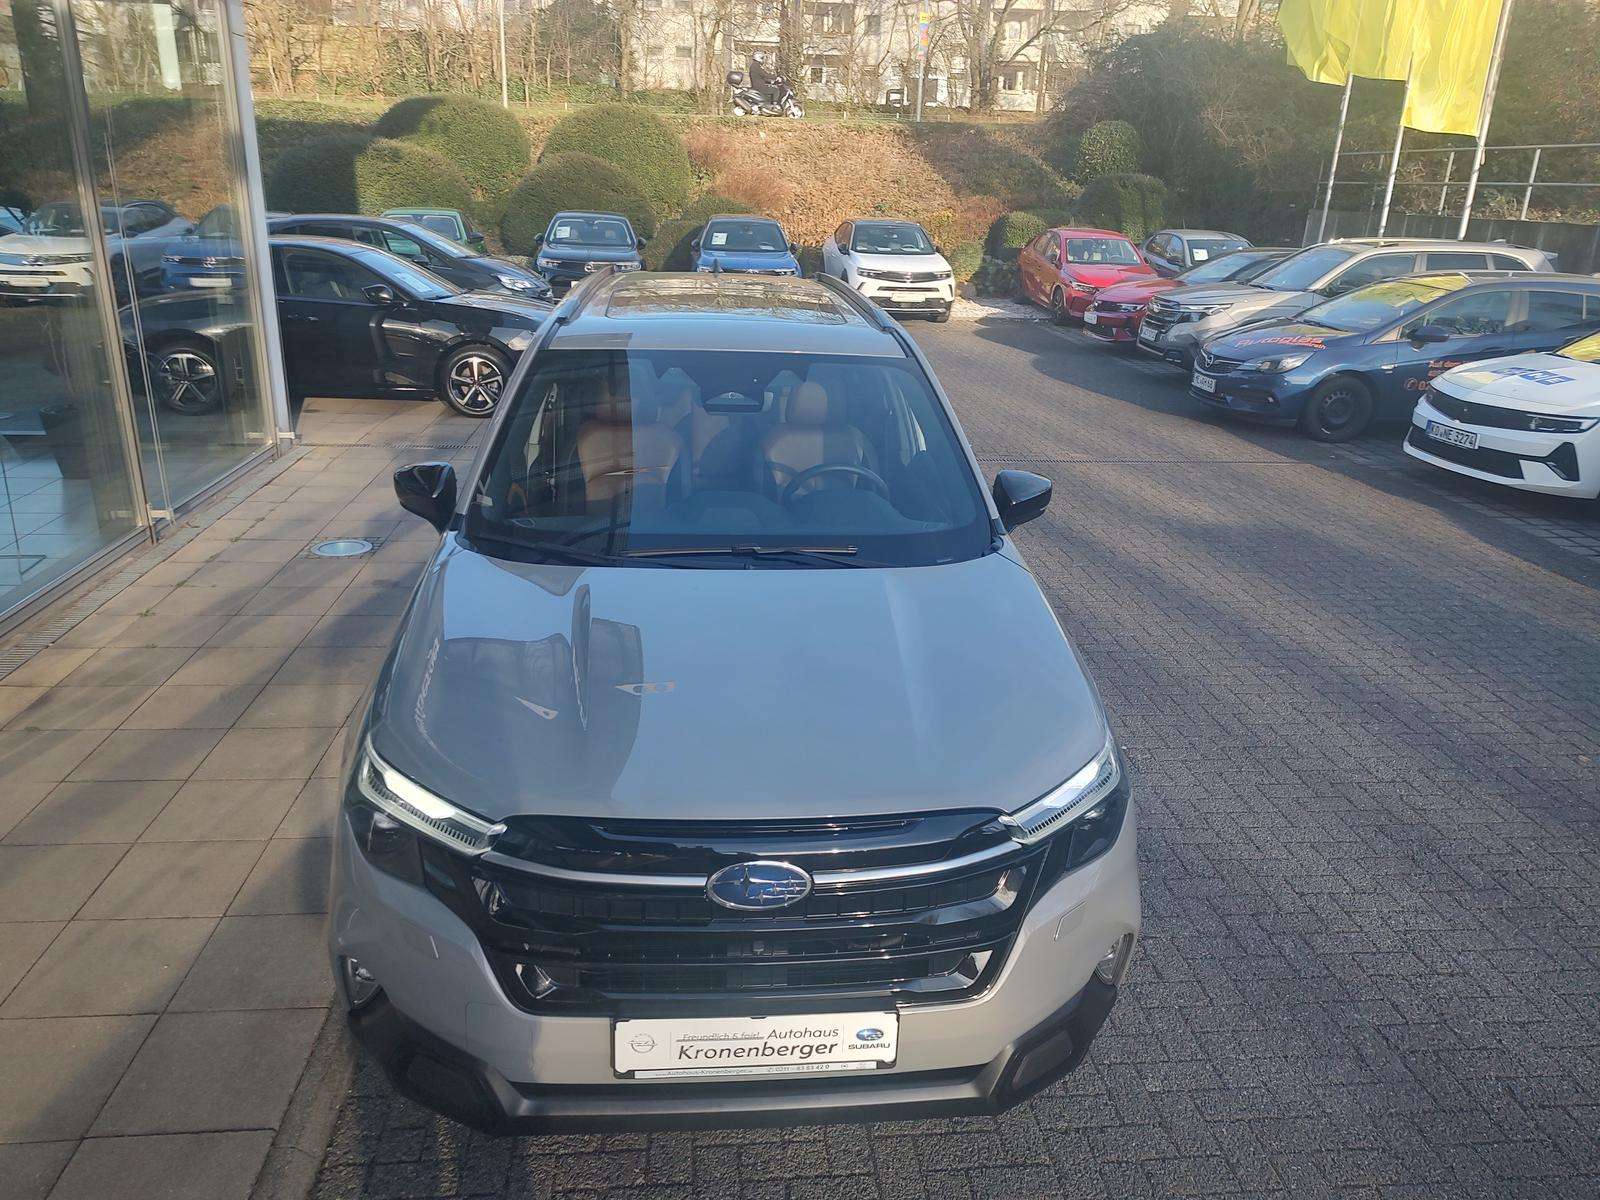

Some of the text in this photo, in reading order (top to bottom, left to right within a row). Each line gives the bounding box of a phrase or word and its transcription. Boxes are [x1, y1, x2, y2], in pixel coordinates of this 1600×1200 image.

[1454, 431, 1475, 447] 3274
[682, 1033, 730, 1041] Freundlich
[766, 1027, 840, 1039] Autohaus
[678, 1040, 838, 1060] Kronenberger
